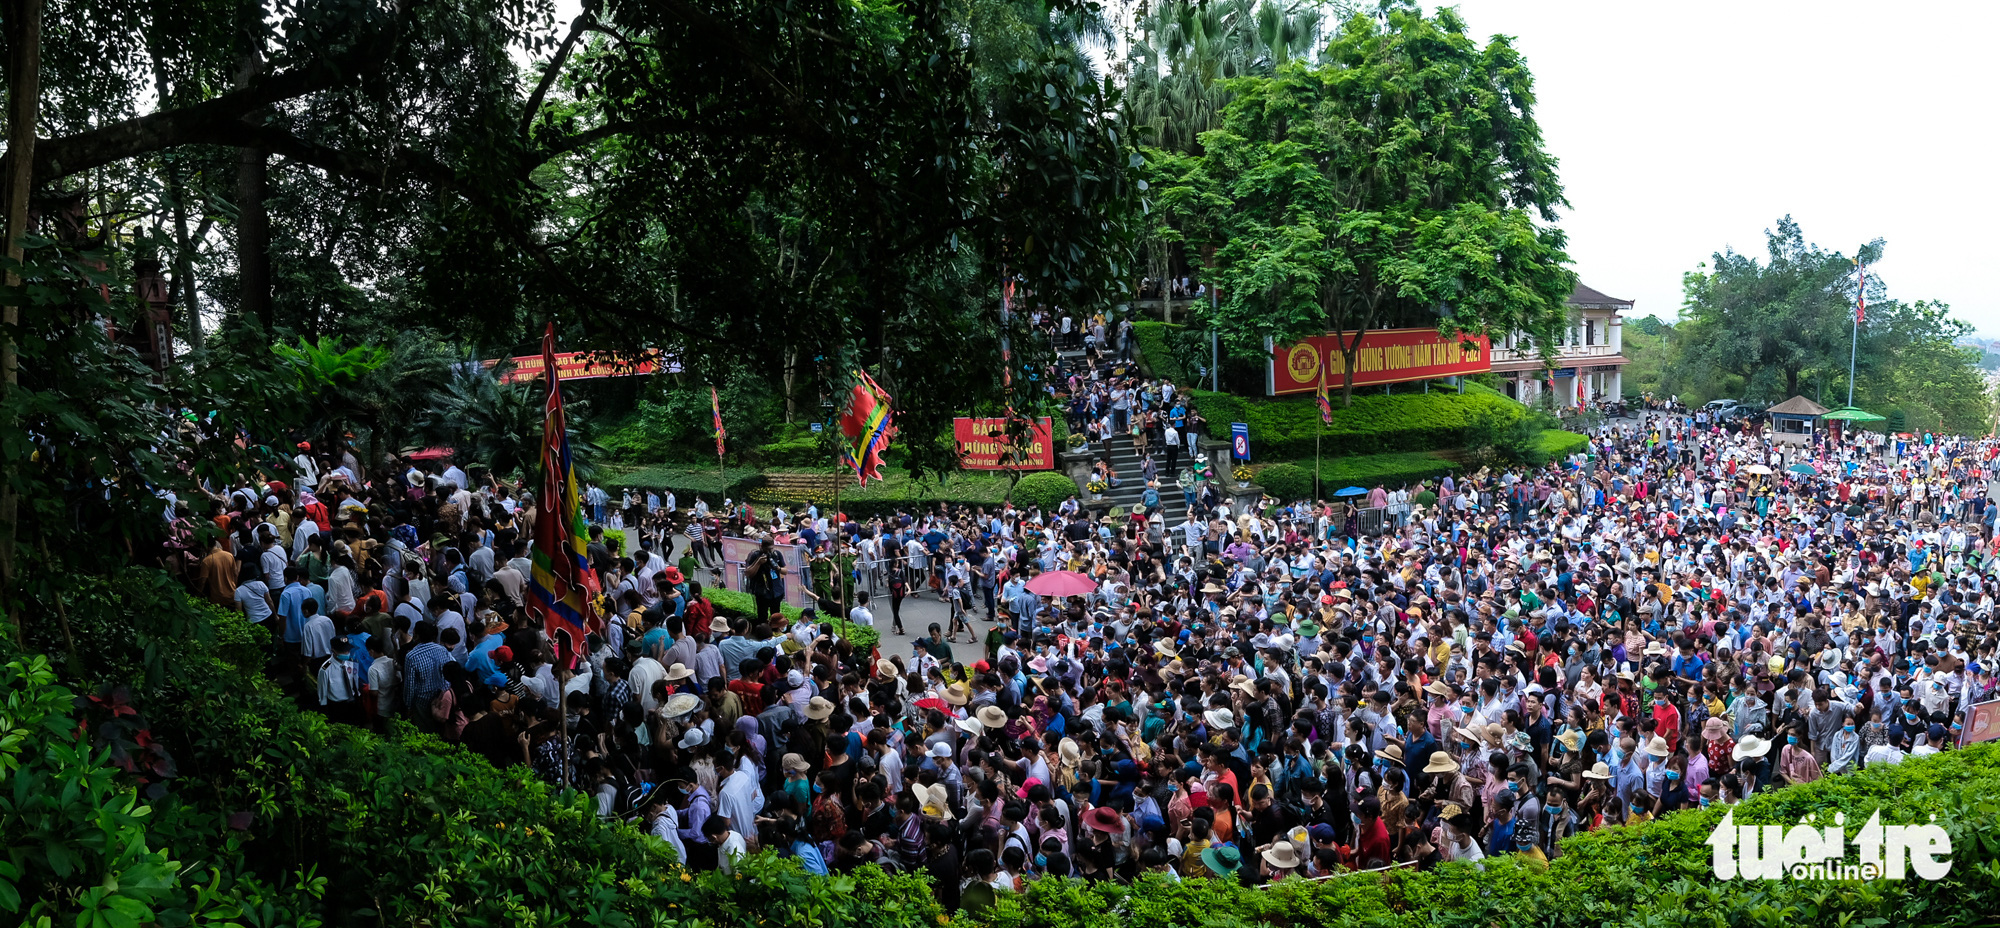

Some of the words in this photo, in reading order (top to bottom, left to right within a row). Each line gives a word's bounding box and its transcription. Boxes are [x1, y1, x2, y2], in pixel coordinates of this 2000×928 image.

[525, 358, 545, 368] HÙN
[1360, 343, 1383, 372] HÙNG
[1385, 344, 1411, 370] VƯƠNG
[1414, 340, 1432, 367] NĂM
[1433, 339, 1447, 365] TÂN
[964, 440, 998, 455] HÙNG
[1001, 442, 1042, 454] VNG
